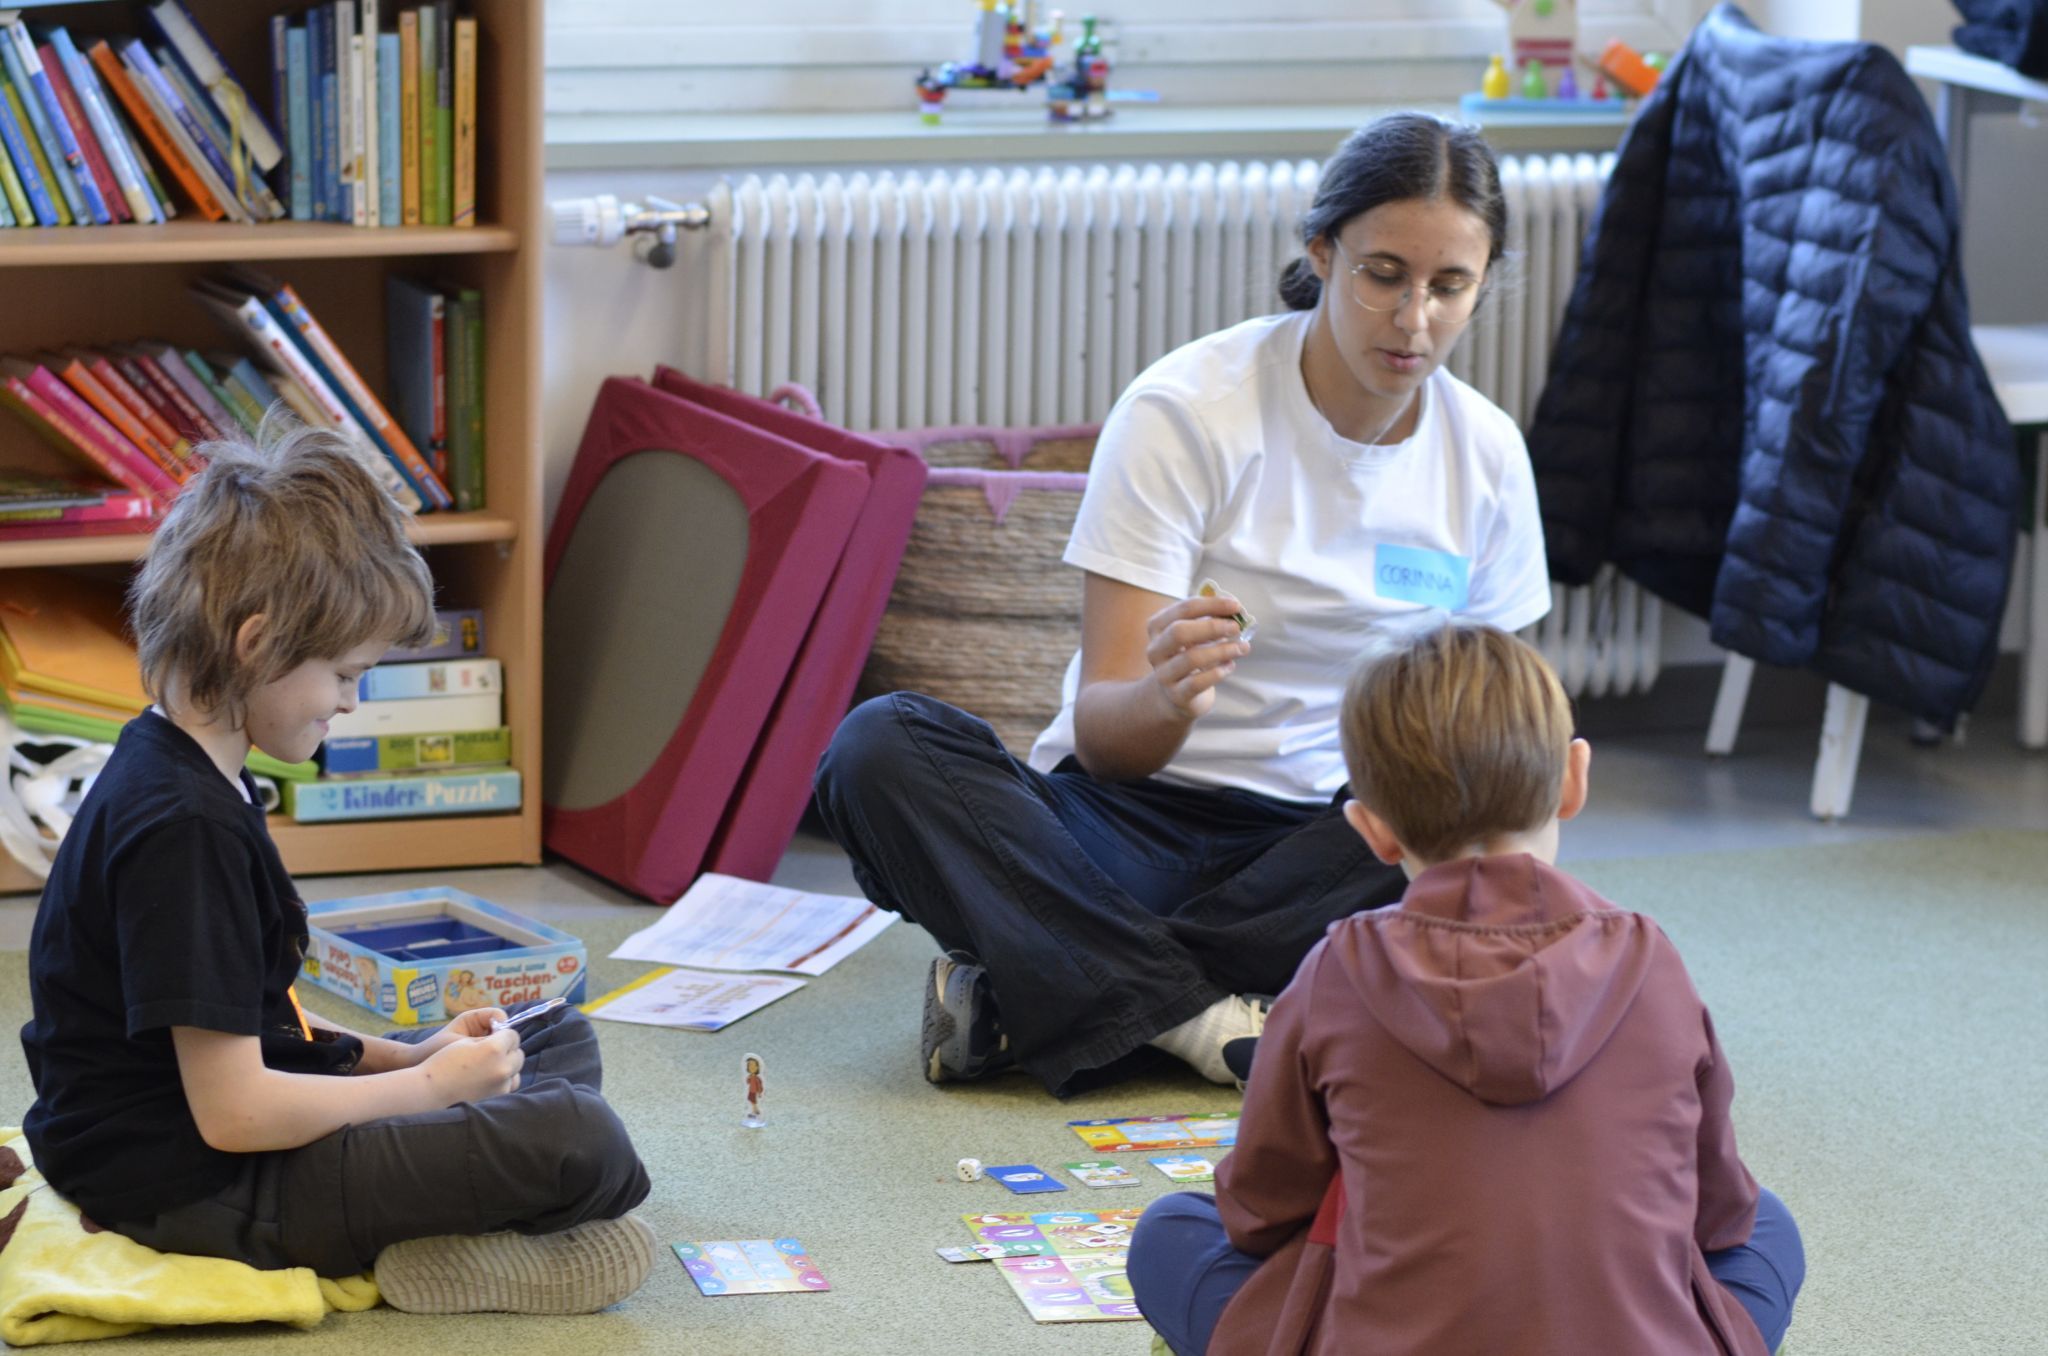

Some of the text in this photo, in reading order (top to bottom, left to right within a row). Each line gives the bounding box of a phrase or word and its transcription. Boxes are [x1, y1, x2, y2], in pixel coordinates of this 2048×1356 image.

[1380, 564, 1454, 593] CORINNA
[484, 972, 557, 991] Taschen-
[499, 985, 541, 1006] Geld
